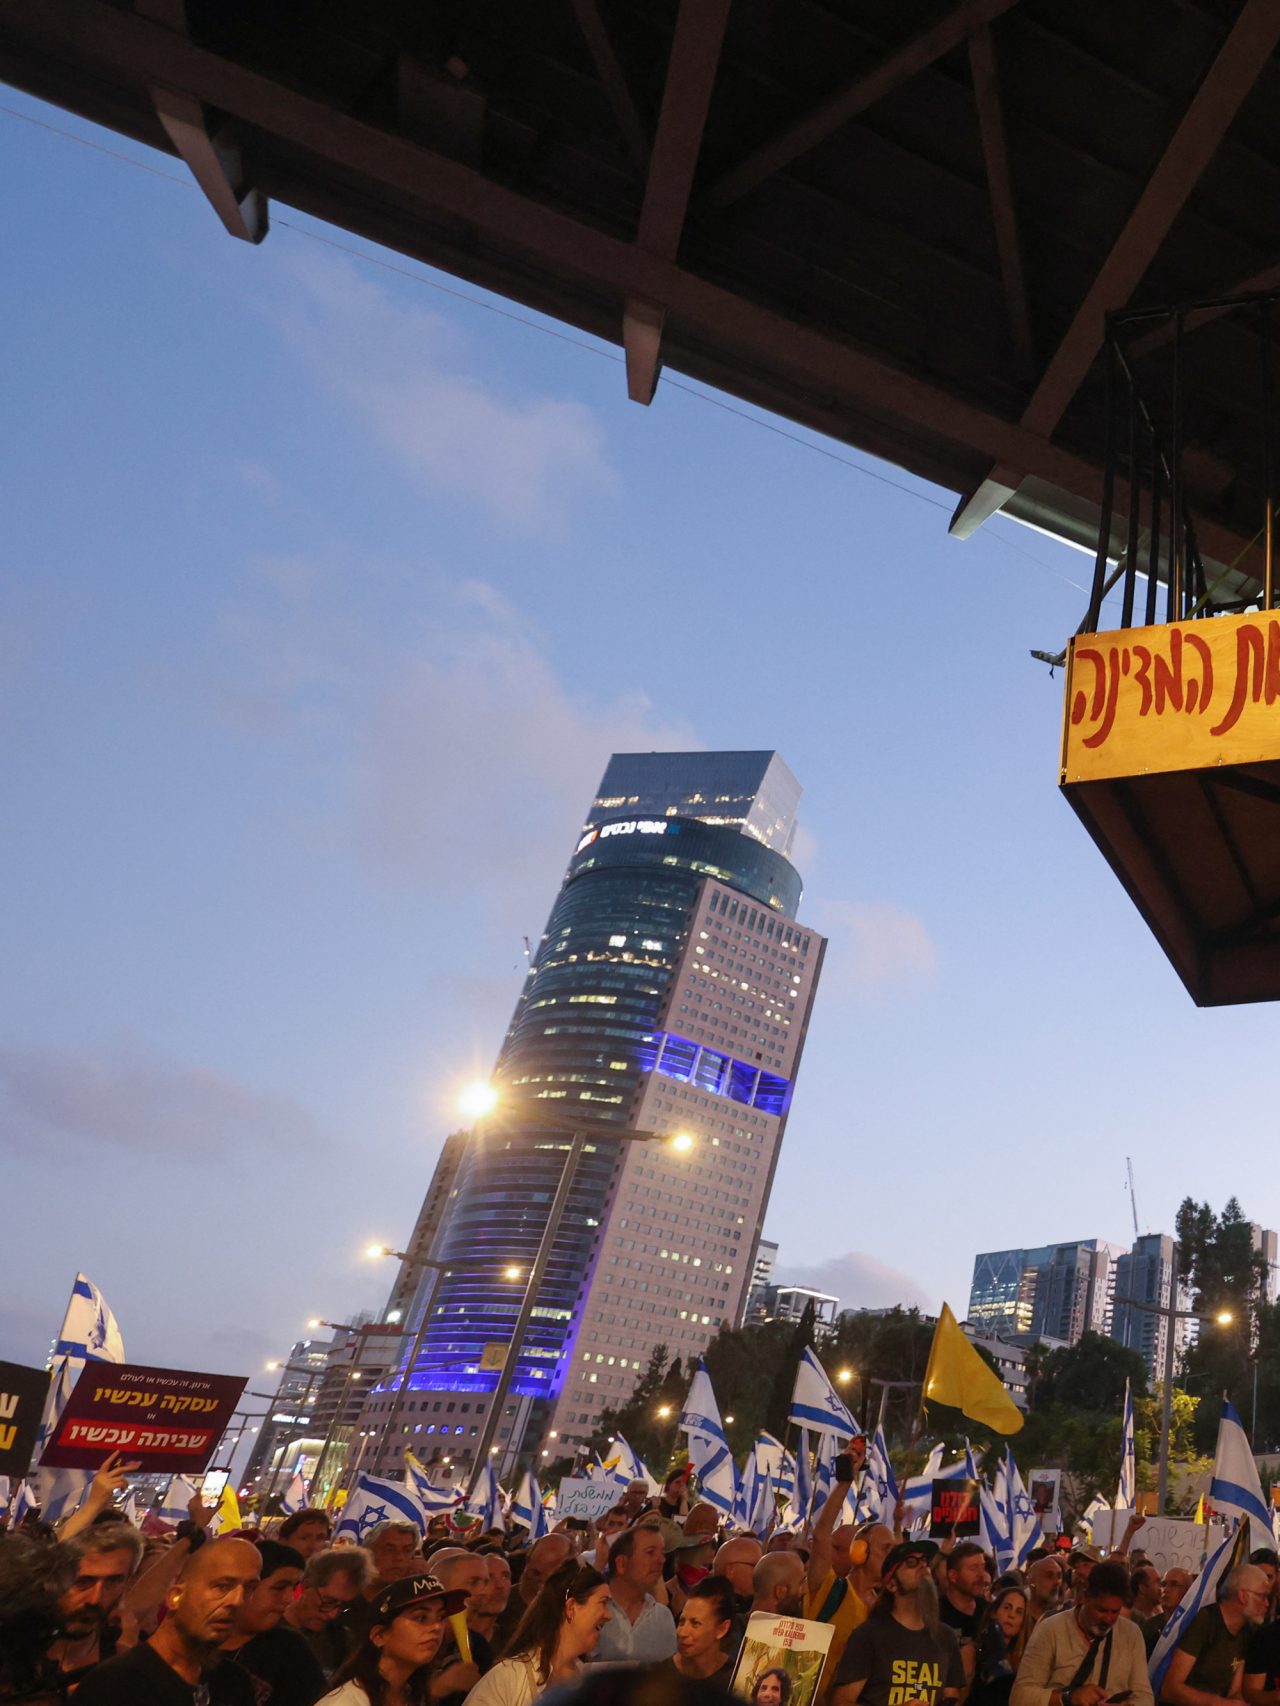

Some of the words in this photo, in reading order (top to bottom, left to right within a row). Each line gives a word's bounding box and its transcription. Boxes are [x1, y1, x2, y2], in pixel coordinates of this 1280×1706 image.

[1072, 627, 1215, 749] המדינה
[120, 1374, 145, 1383] לעולם
[146, 1376, 155, 1384] או
[156, 1377, 178, 1387] עכשיו
[178, 1379, 187, 1387] זה
[93, 1387, 158, 1407] עכשיו
[160, 1395, 219, 1413] עסקה
[147, 1412, 156, 1420] או
[69, 1424, 136, 1444] עכשיו
[137, 1431, 207, 1448] שביתה
[568, 1485, 614, 1501] ממשלת
[892, 1659, 943, 1687] SEAL
